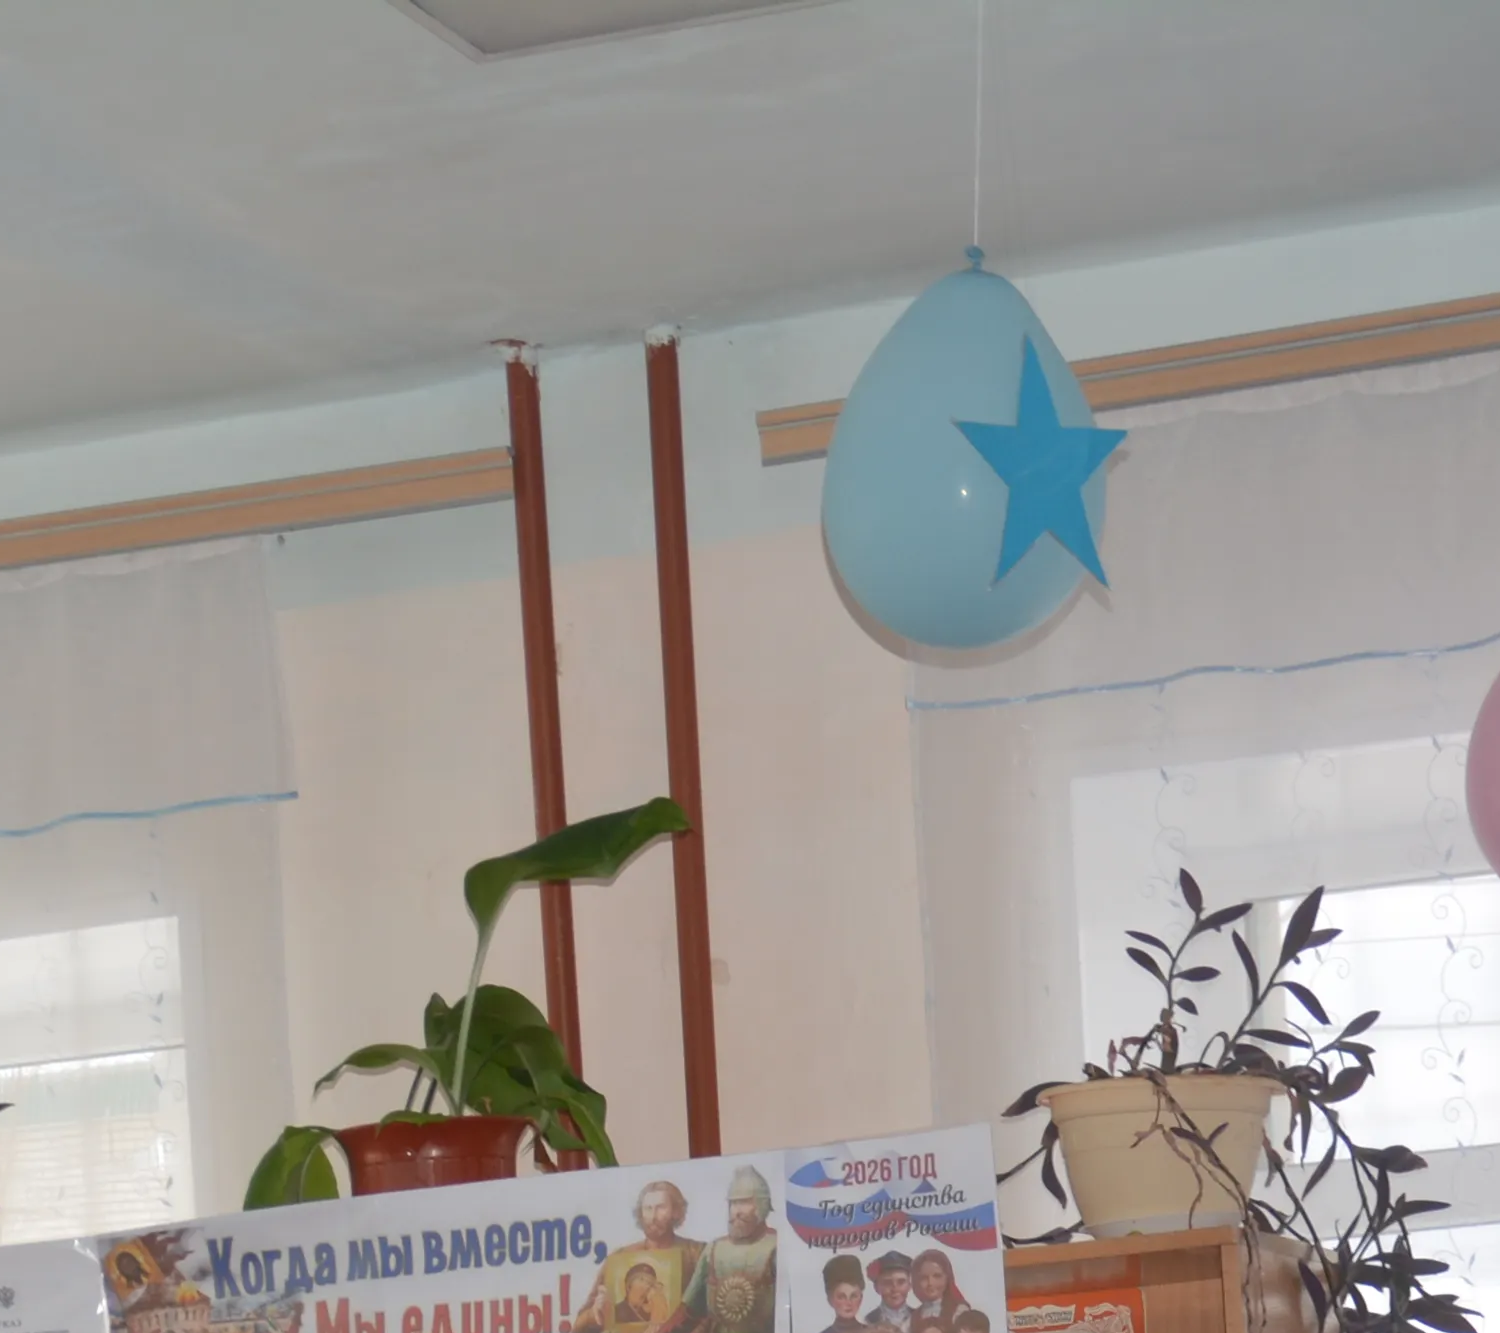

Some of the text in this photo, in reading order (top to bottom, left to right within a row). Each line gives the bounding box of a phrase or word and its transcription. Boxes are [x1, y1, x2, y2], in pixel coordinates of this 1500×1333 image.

[841, 1152, 938, 1186] 2026 ГОД
[818, 1183, 967, 1222] Год единства
[807, 1217, 980, 1254] народов России
[207, 1213, 608, 1298] Когда мы вместе,
